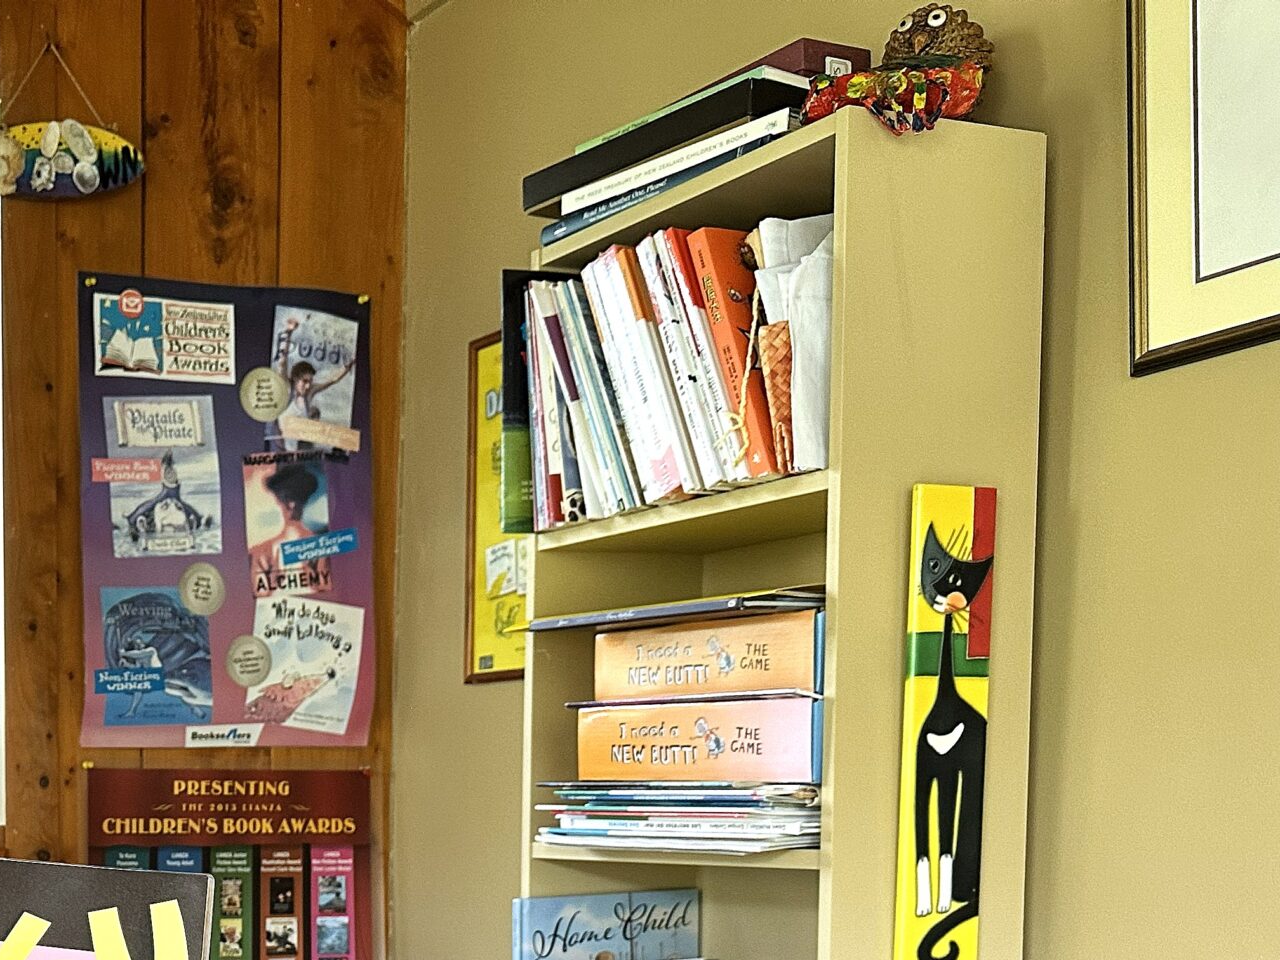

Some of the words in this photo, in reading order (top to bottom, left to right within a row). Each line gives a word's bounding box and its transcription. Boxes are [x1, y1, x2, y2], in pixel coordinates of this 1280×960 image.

[686, 141, 724, 159] CHILDREN'S
[726, 132, 748, 146] BOOKS
[127, 408, 185, 428] Pigtails
[151, 425, 193, 442] Pirate
[257, 571, 329, 592] ALCHEMY
[119, 603, 173, 618] Weaving
[745, 642, 769, 657] THE
[740, 656, 771, 671] GAME
[628, 665, 660, 686] NEW
[665, 664, 710, 686] BUTT!
[630, 722, 666, 738] need
[736, 726, 761, 741] THE
[610, 744, 645, 765] NEW
[650, 744, 698, 765] BUTT!
[730, 740, 763, 755] GAME
[173, 780, 290, 796] PRESENTING
[182, 803, 203, 811] THE
[209, 803, 237, 811] 2013
[102, 818, 218, 835] CHILDREN'S
[223, 818, 273, 834] BOOK
[278, 818, 356, 834] AWARDS
[532, 910, 618, 960] Home
[614, 900, 694, 940] Child
